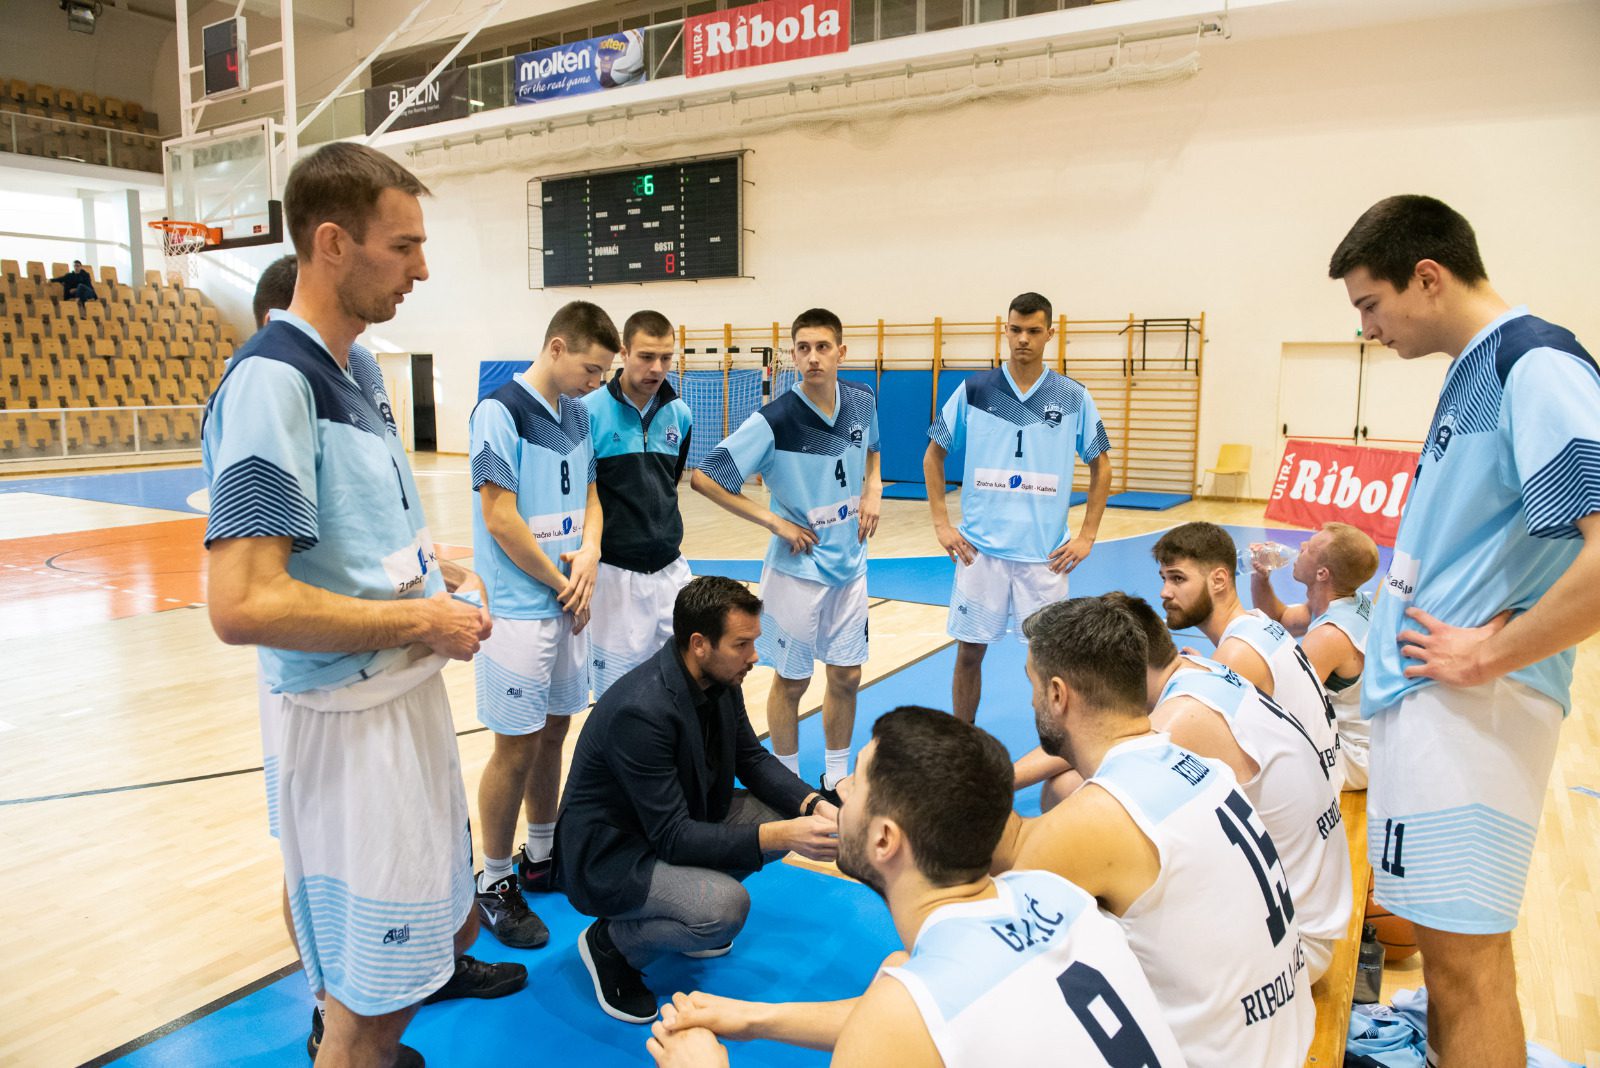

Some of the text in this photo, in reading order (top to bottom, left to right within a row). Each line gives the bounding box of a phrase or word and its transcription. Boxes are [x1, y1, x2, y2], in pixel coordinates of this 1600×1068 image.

[693, 24, 703, 64] ULTRA
[520, 49, 590, 82] molten
[532, 81, 546, 93] the
[547, 76, 566, 91] real
[566, 75, 592, 91] game
[665, 253, 675, 273] 8
[1014, 430, 1024, 458] 1
[560, 460, 571, 495] 8
[834, 459, 848, 488] 4
[1272, 452, 1296, 500] ULTRA
[1290, 459, 1409, 518] Ribol
[1381, 817, 1405, 879] 11
[1214, 788, 1296, 948] 15
